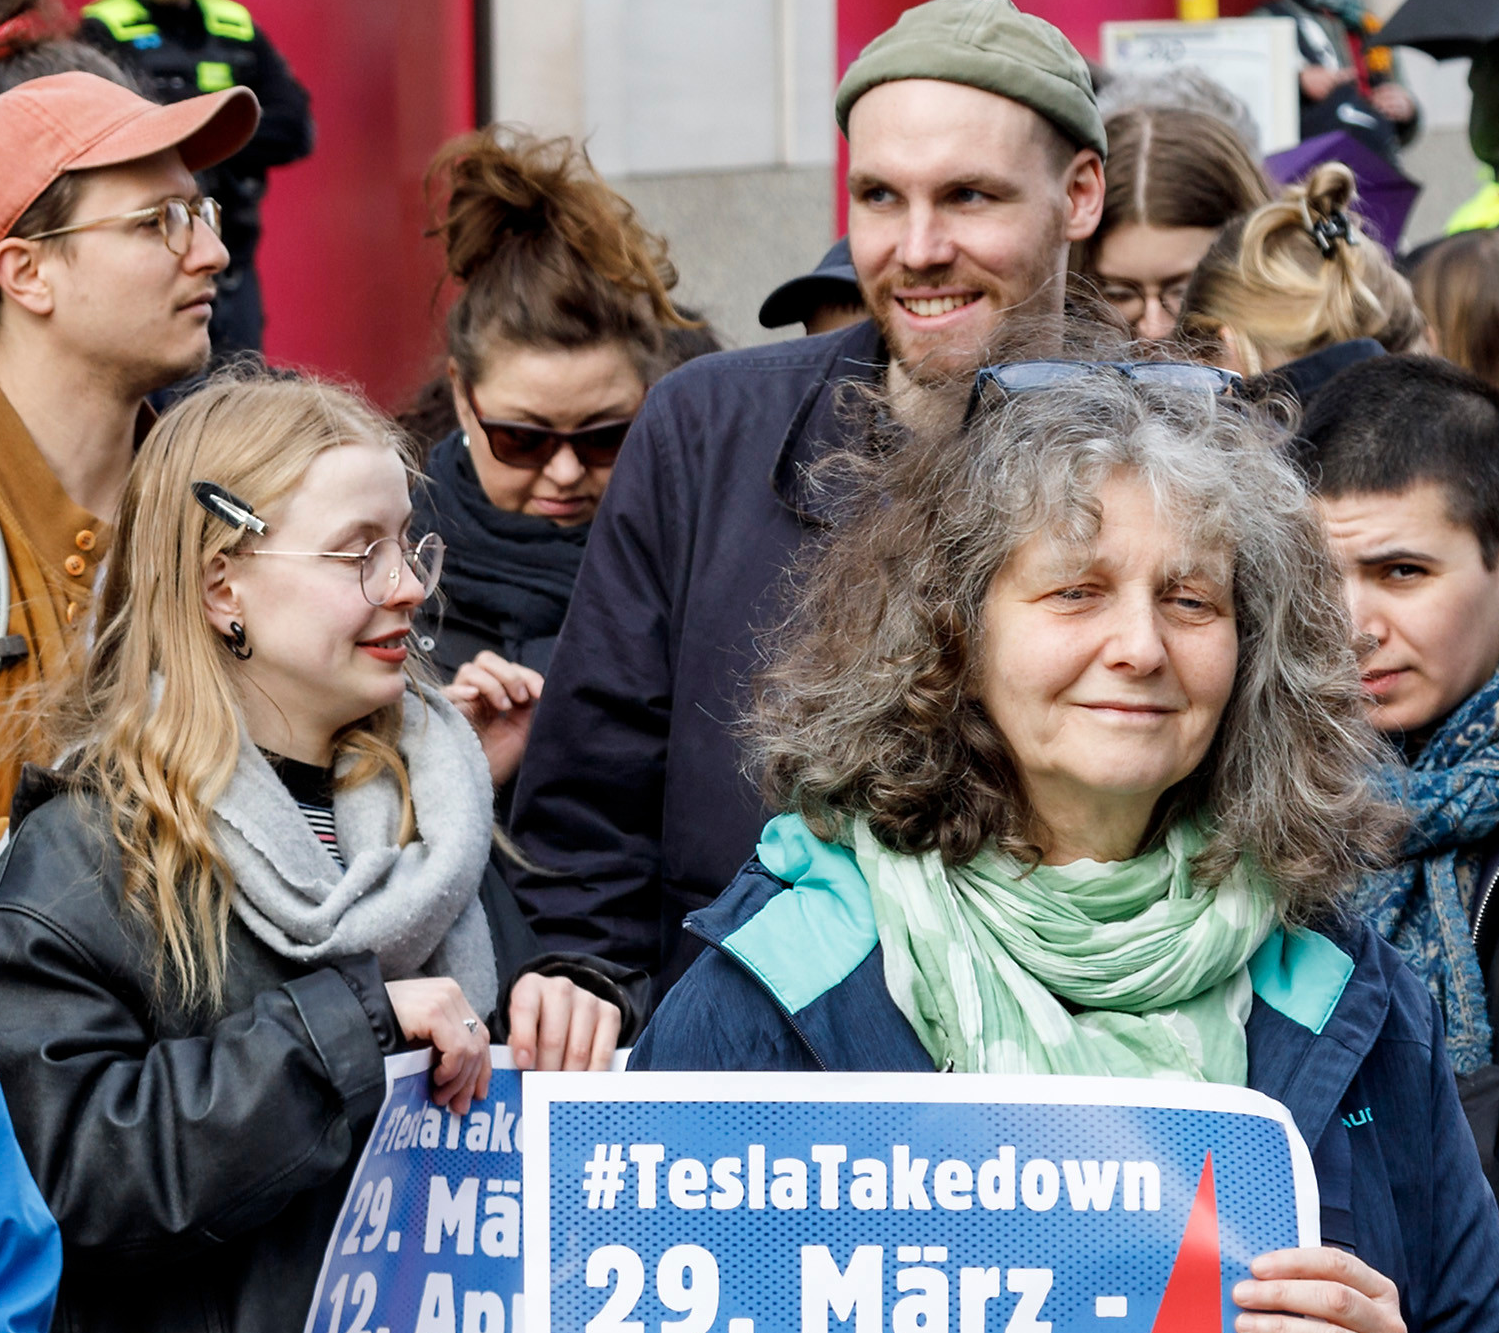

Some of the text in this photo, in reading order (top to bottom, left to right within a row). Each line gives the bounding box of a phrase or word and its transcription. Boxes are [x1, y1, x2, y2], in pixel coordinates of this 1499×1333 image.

[581, 1143, 1162, 1212] #TeslaTakedown
[340, 1174, 523, 1259] 29. Mä
